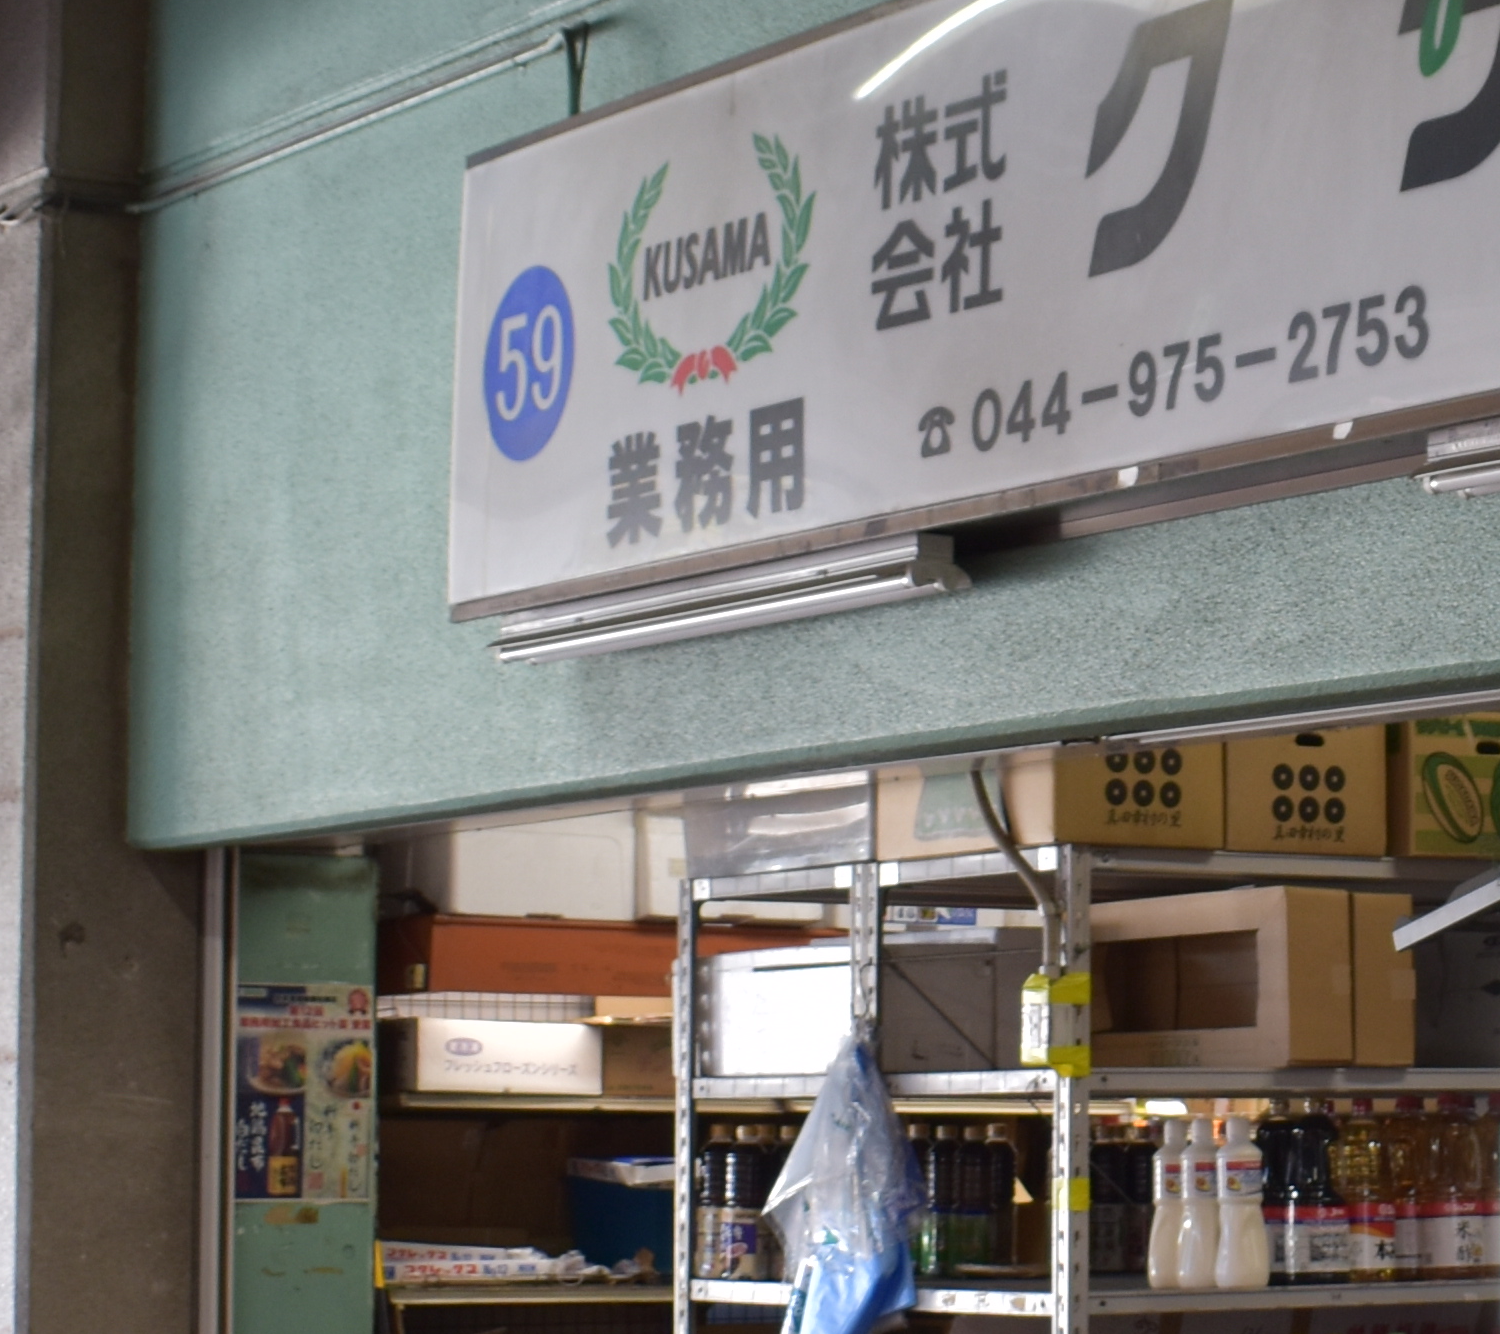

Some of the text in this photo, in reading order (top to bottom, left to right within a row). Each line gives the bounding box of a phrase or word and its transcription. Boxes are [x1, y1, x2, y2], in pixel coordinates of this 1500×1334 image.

[874, 72, 1007, 210] 株式
[642, 211, 771, 302] KUSAMA
[871, 207, 1003, 330] 会社
[494, 308, 562, 419] 59
[971, 287, 1429, 452] 044-975-2753
[606, 396, 806, 548] 業務用
